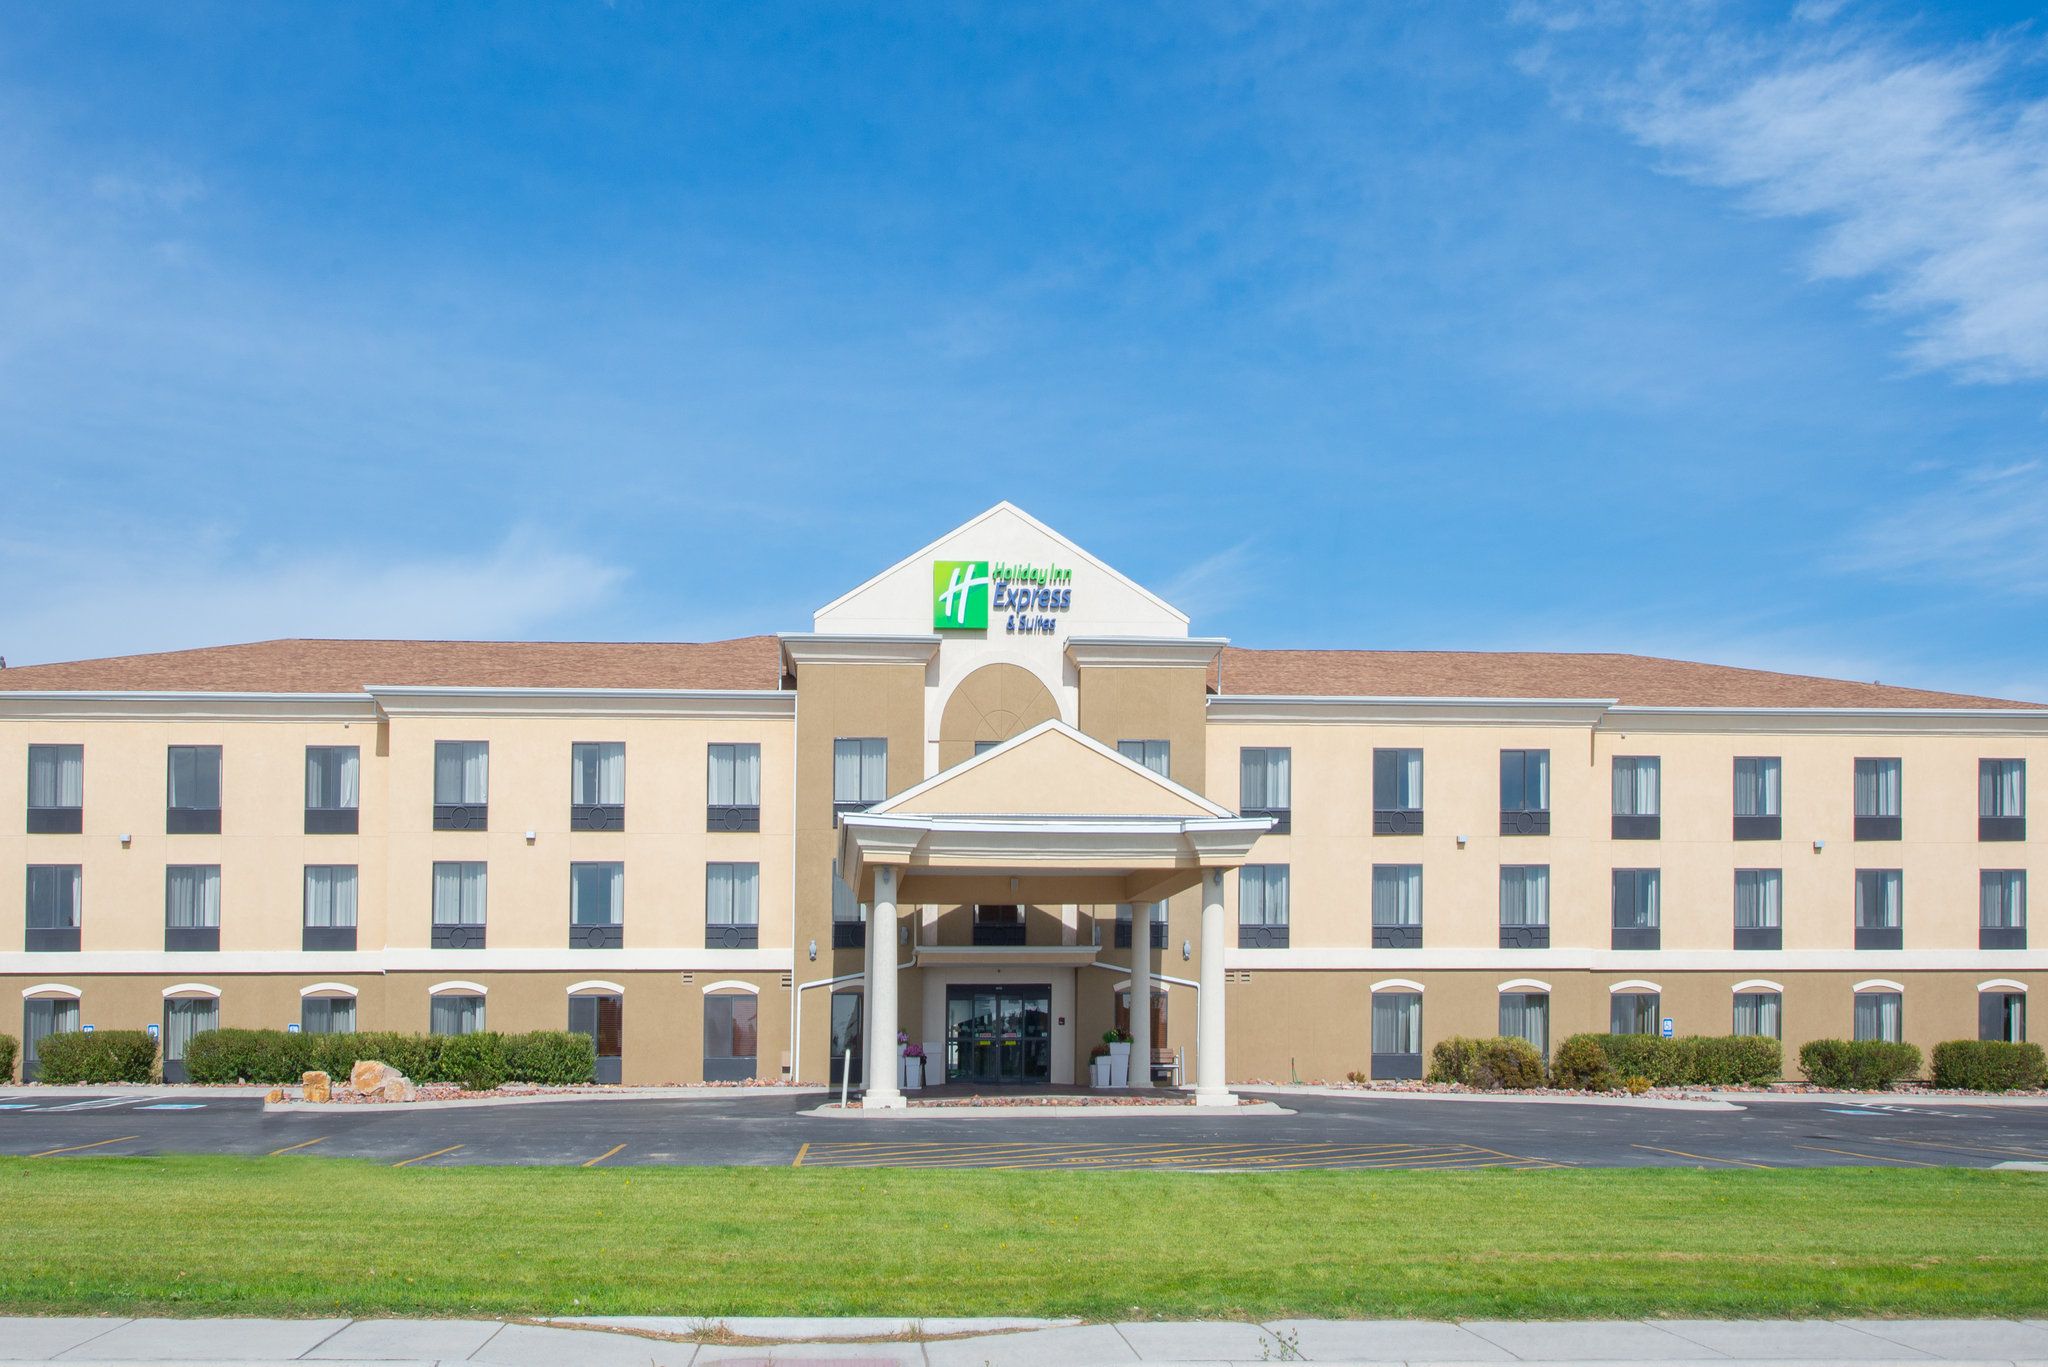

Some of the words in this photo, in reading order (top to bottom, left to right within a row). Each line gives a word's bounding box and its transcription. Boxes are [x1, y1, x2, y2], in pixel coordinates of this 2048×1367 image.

[993, 561, 1047, 586] Holiday
[1049, 562, 1072, 581] Inn
[993, 582, 1072, 613] Express
[1007, 614, 1015, 631] &
[1018, 614, 1056, 631] Suites
